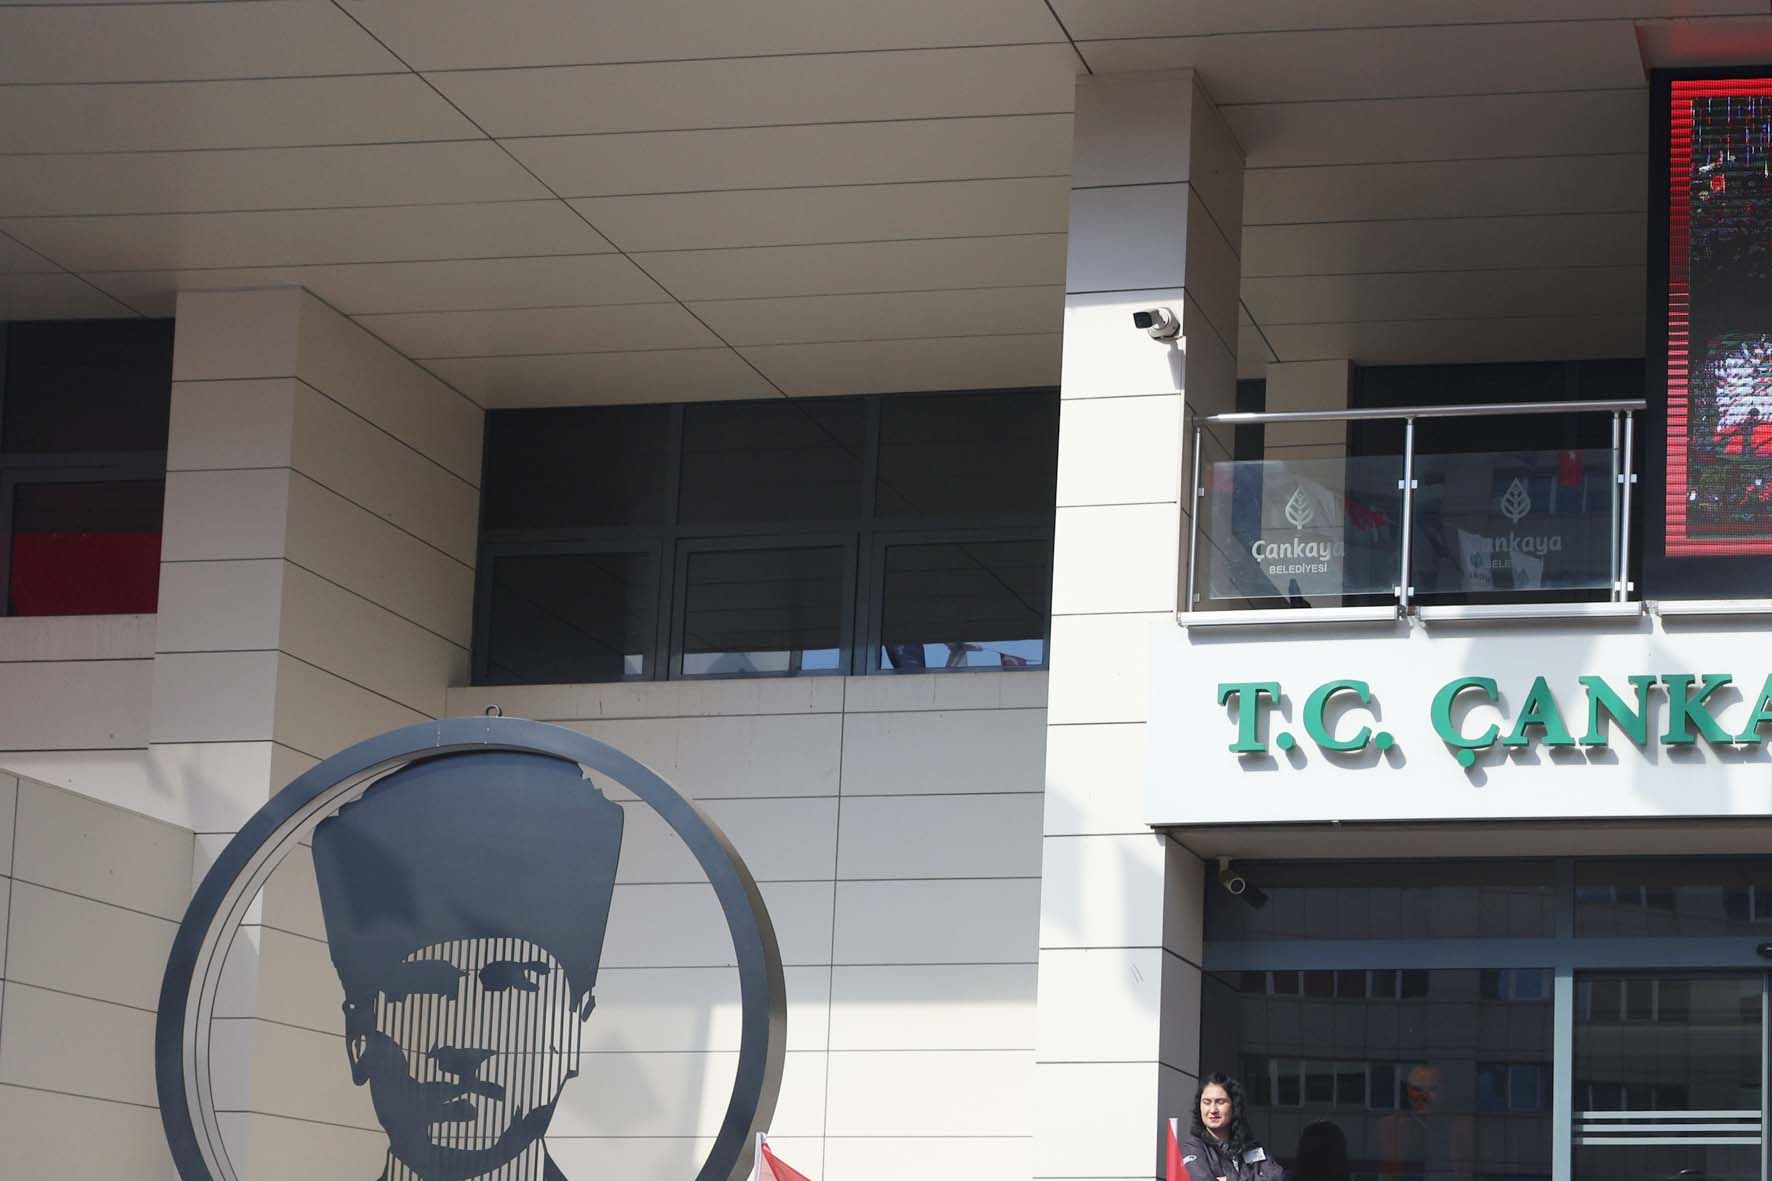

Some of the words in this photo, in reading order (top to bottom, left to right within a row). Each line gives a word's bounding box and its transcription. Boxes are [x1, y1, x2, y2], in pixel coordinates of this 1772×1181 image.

[1251, 537, 1345, 562] Çankaya
[1269, 563, 1328, 575] BELEDİYESİ
[1217, 678, 1395, 754] T.C.
